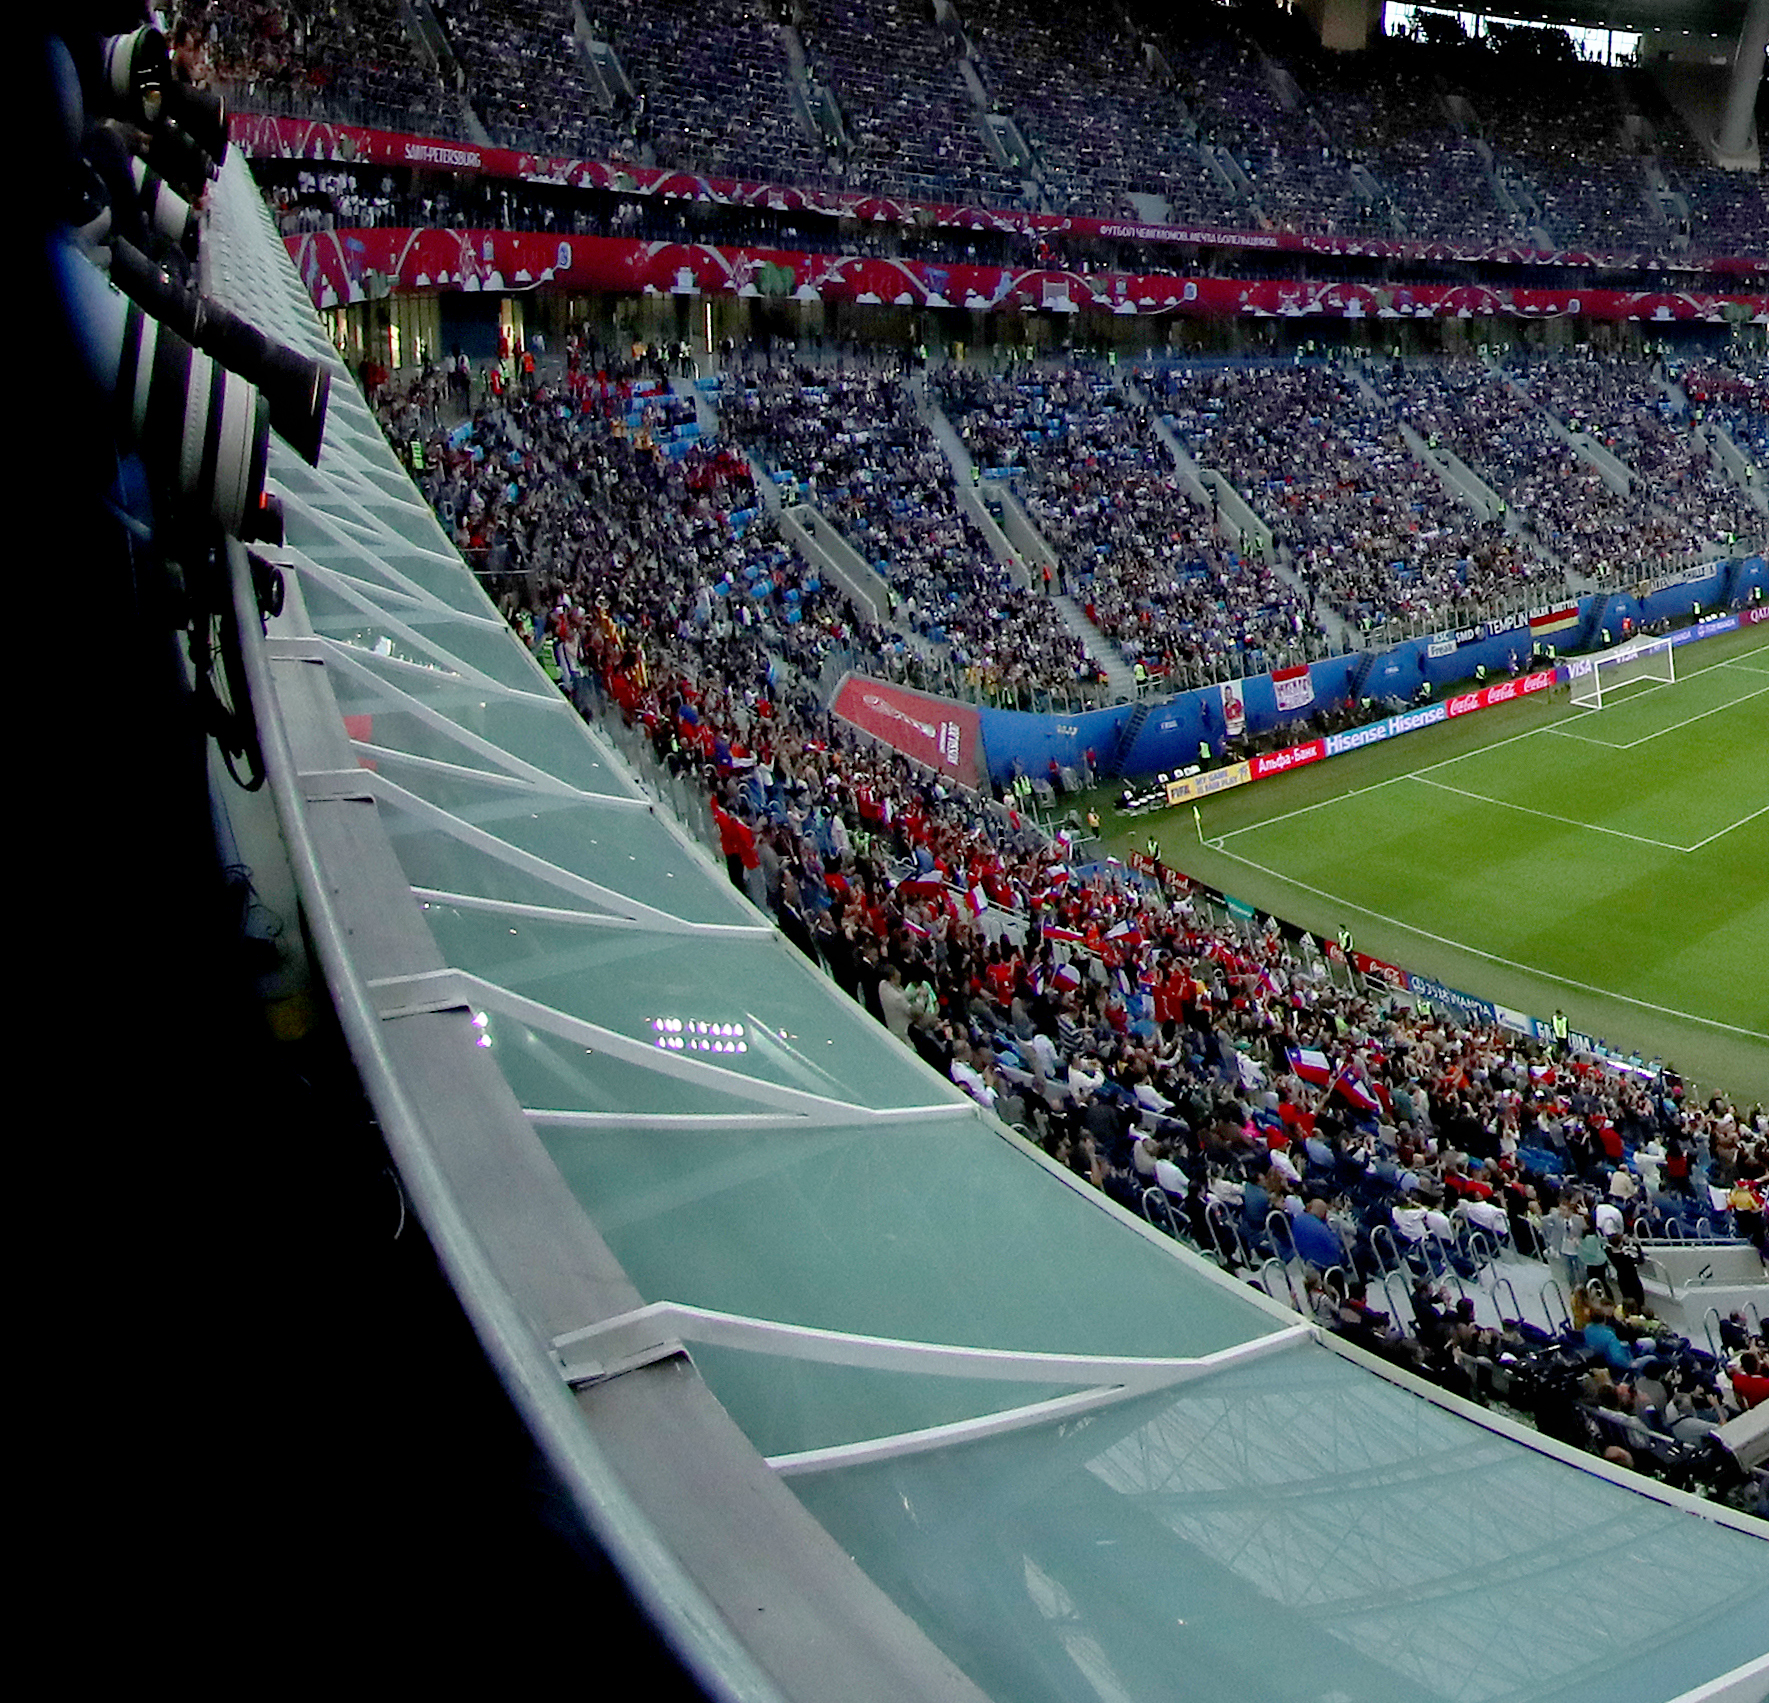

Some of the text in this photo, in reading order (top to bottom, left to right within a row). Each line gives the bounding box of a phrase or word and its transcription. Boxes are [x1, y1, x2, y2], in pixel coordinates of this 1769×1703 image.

[1487, 612, 1528, 635] TEMPLIN
[1456, 629, 1474, 643] SMD
[1567, 659, 1592, 678] VISA
[1389, 707, 1444, 736] Hisense
[1325, 725, 1386, 755] Hisense
[1162, 868, 1188, 888] Bud
